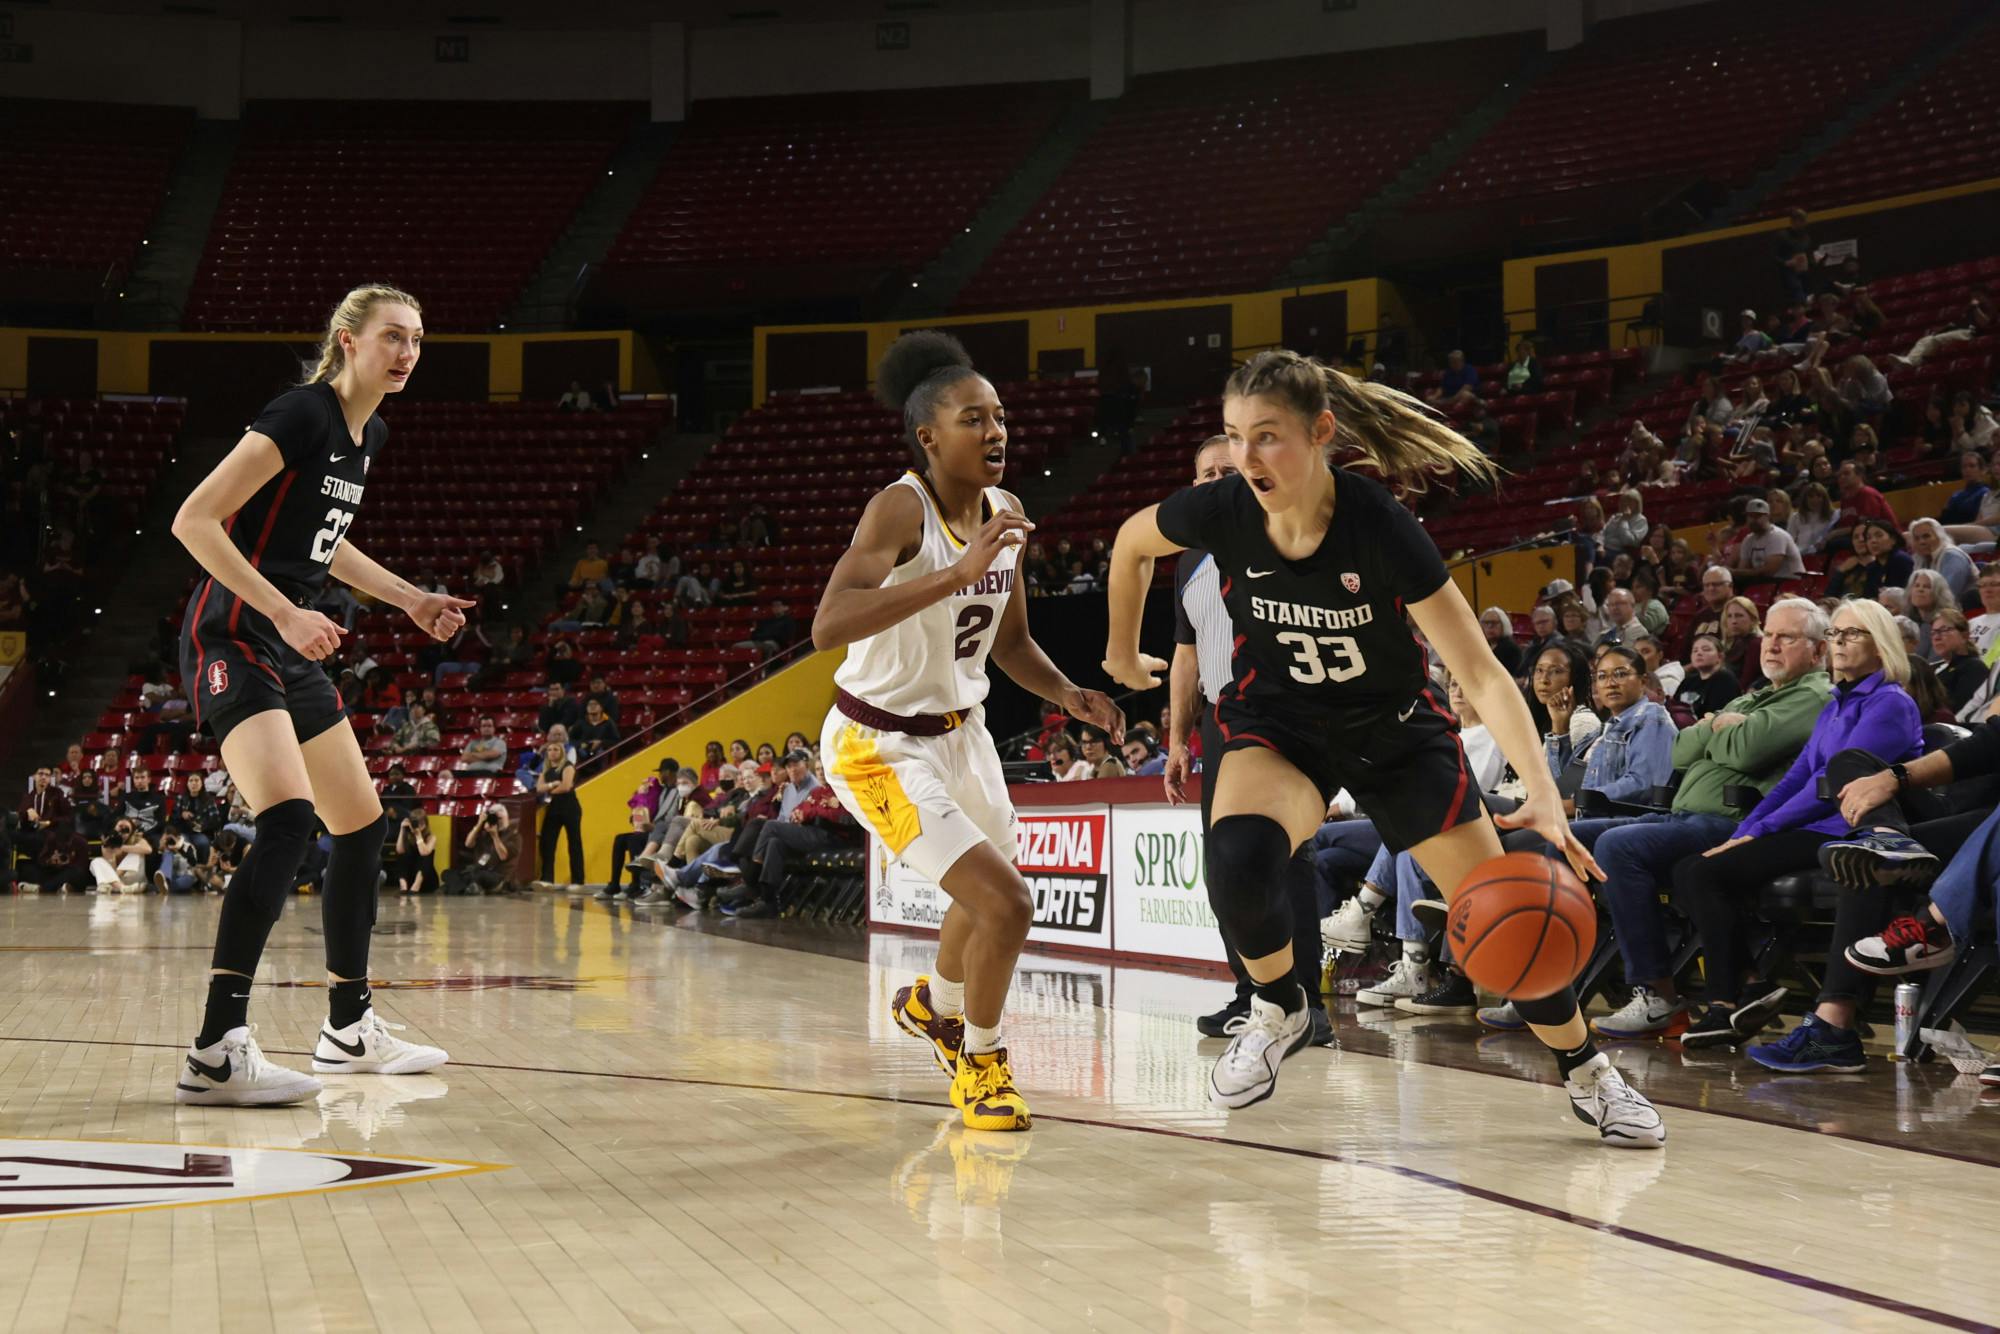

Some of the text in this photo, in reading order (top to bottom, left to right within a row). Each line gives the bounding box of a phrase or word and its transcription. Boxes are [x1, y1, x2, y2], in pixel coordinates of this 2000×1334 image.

[1706, 311, 1720, 337] Q
[310, 507, 354, 565] 22
[974, 571, 1014, 596] DEVIL
[954, 604, 994, 661] 2
[1251, 596, 1373, 629] STANFORD
[1276, 631, 1367, 684] 33
[1017, 821, 1093, 867] RIZONA
[1135, 830, 1207, 890] SPRO
[1023, 877, 1098, 927] ORTS
[1140, 898, 1219, 929] FARMERS MA
